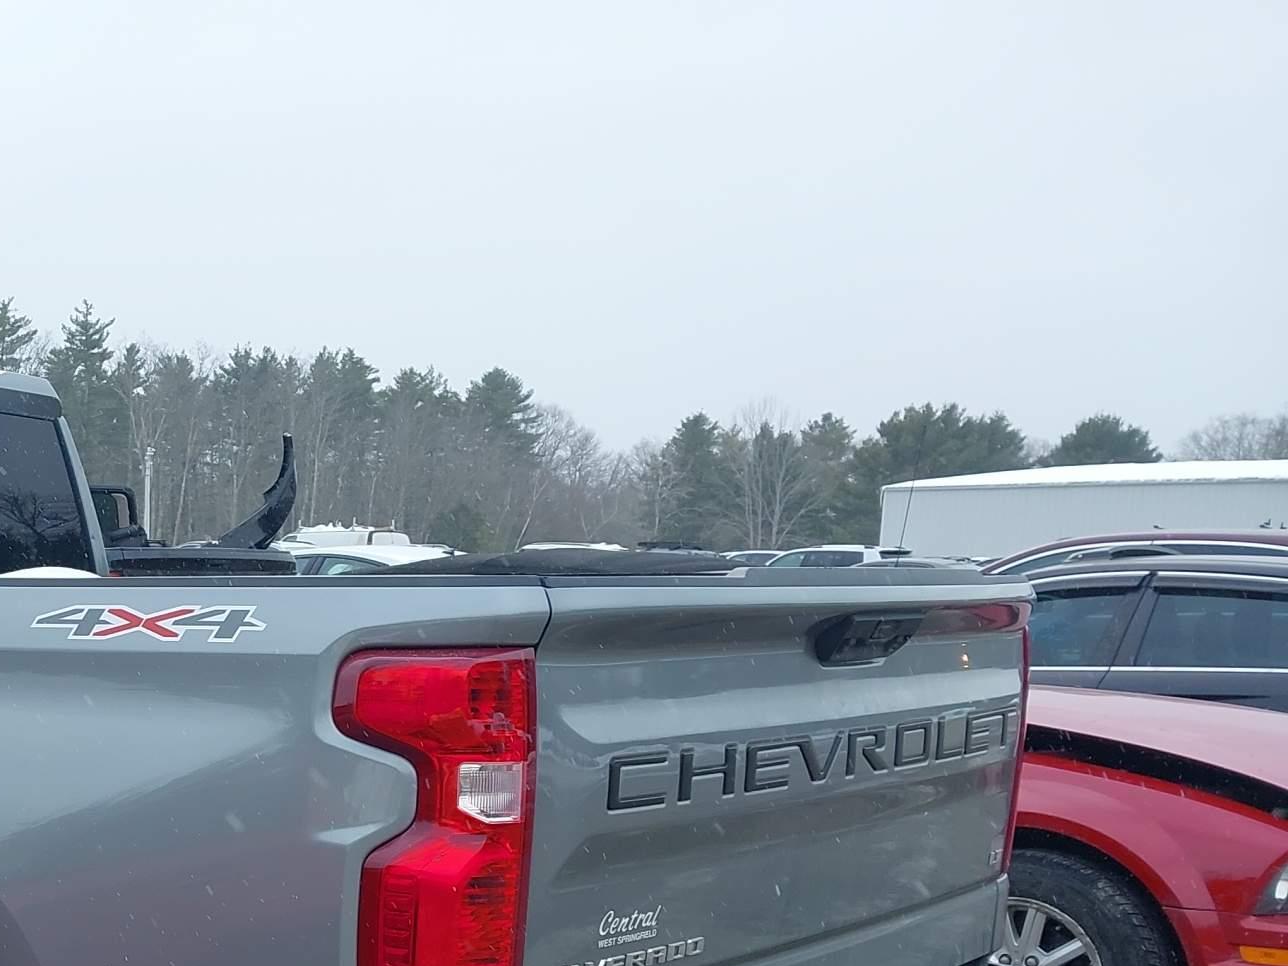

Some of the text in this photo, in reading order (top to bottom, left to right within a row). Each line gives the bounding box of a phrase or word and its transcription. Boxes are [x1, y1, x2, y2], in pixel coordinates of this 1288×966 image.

[607, 702, 1018, 814] CHEVROLET
[599, 905, 662, 936] Central
[598, 929, 657, 949] WEST SPRINGFIELD
